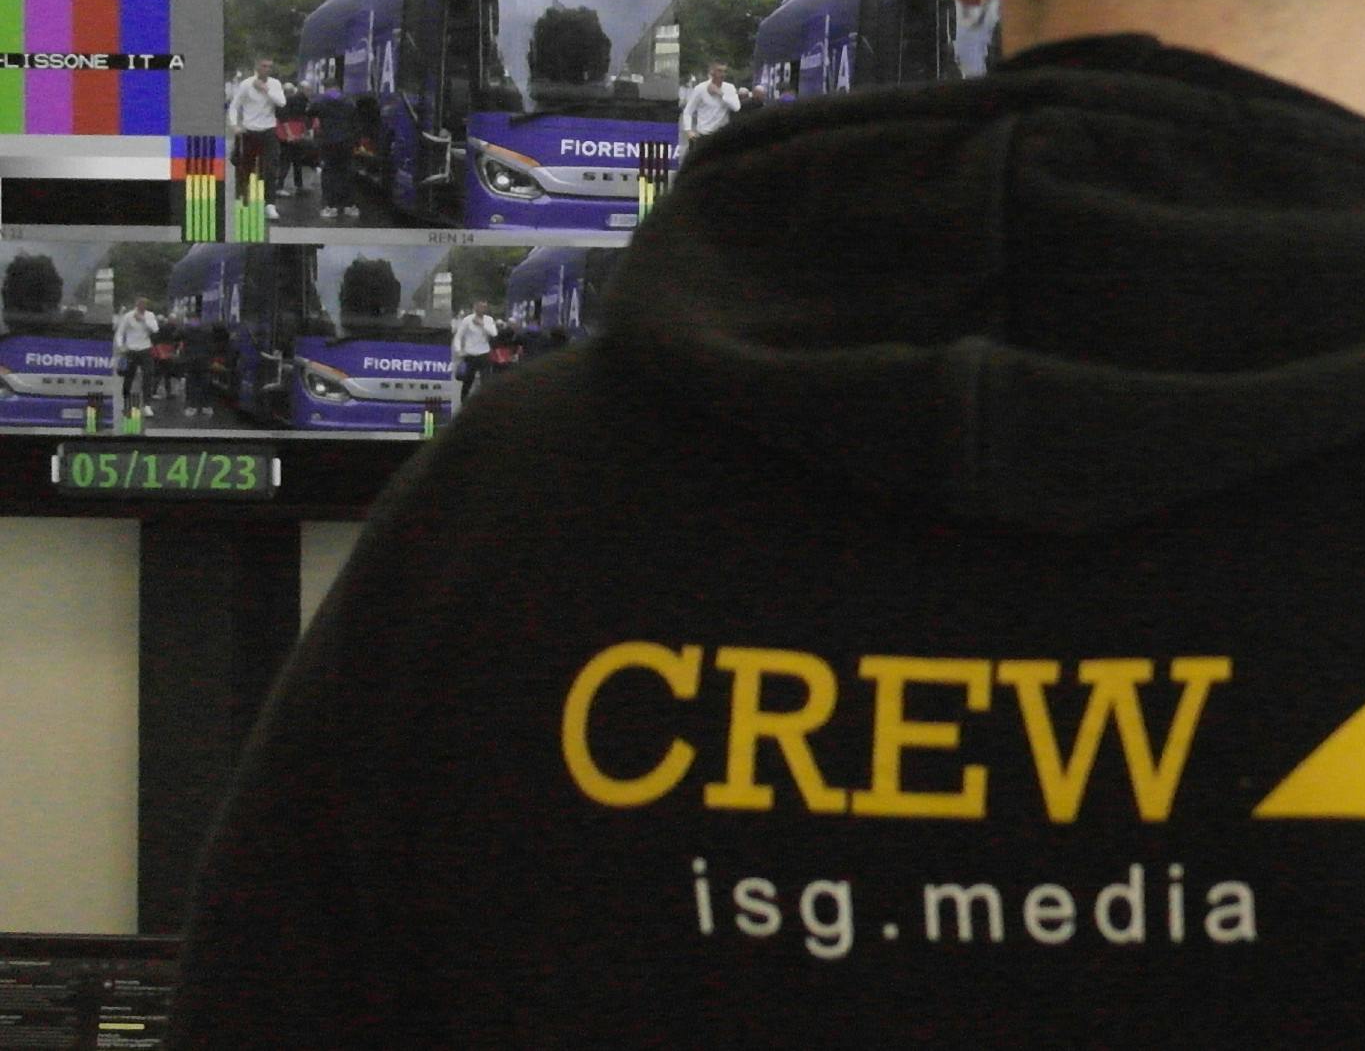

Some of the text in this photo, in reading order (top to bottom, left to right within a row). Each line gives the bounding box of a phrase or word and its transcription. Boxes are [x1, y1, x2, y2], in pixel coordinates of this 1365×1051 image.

[128, 55, 153, 69] IT
[168, 55, 185, 69] A
[72, 452, 257, 490] 05/14/23
[561, 641, 1231, 822] CREW
[692, 857, 1257, 959] isg.media
